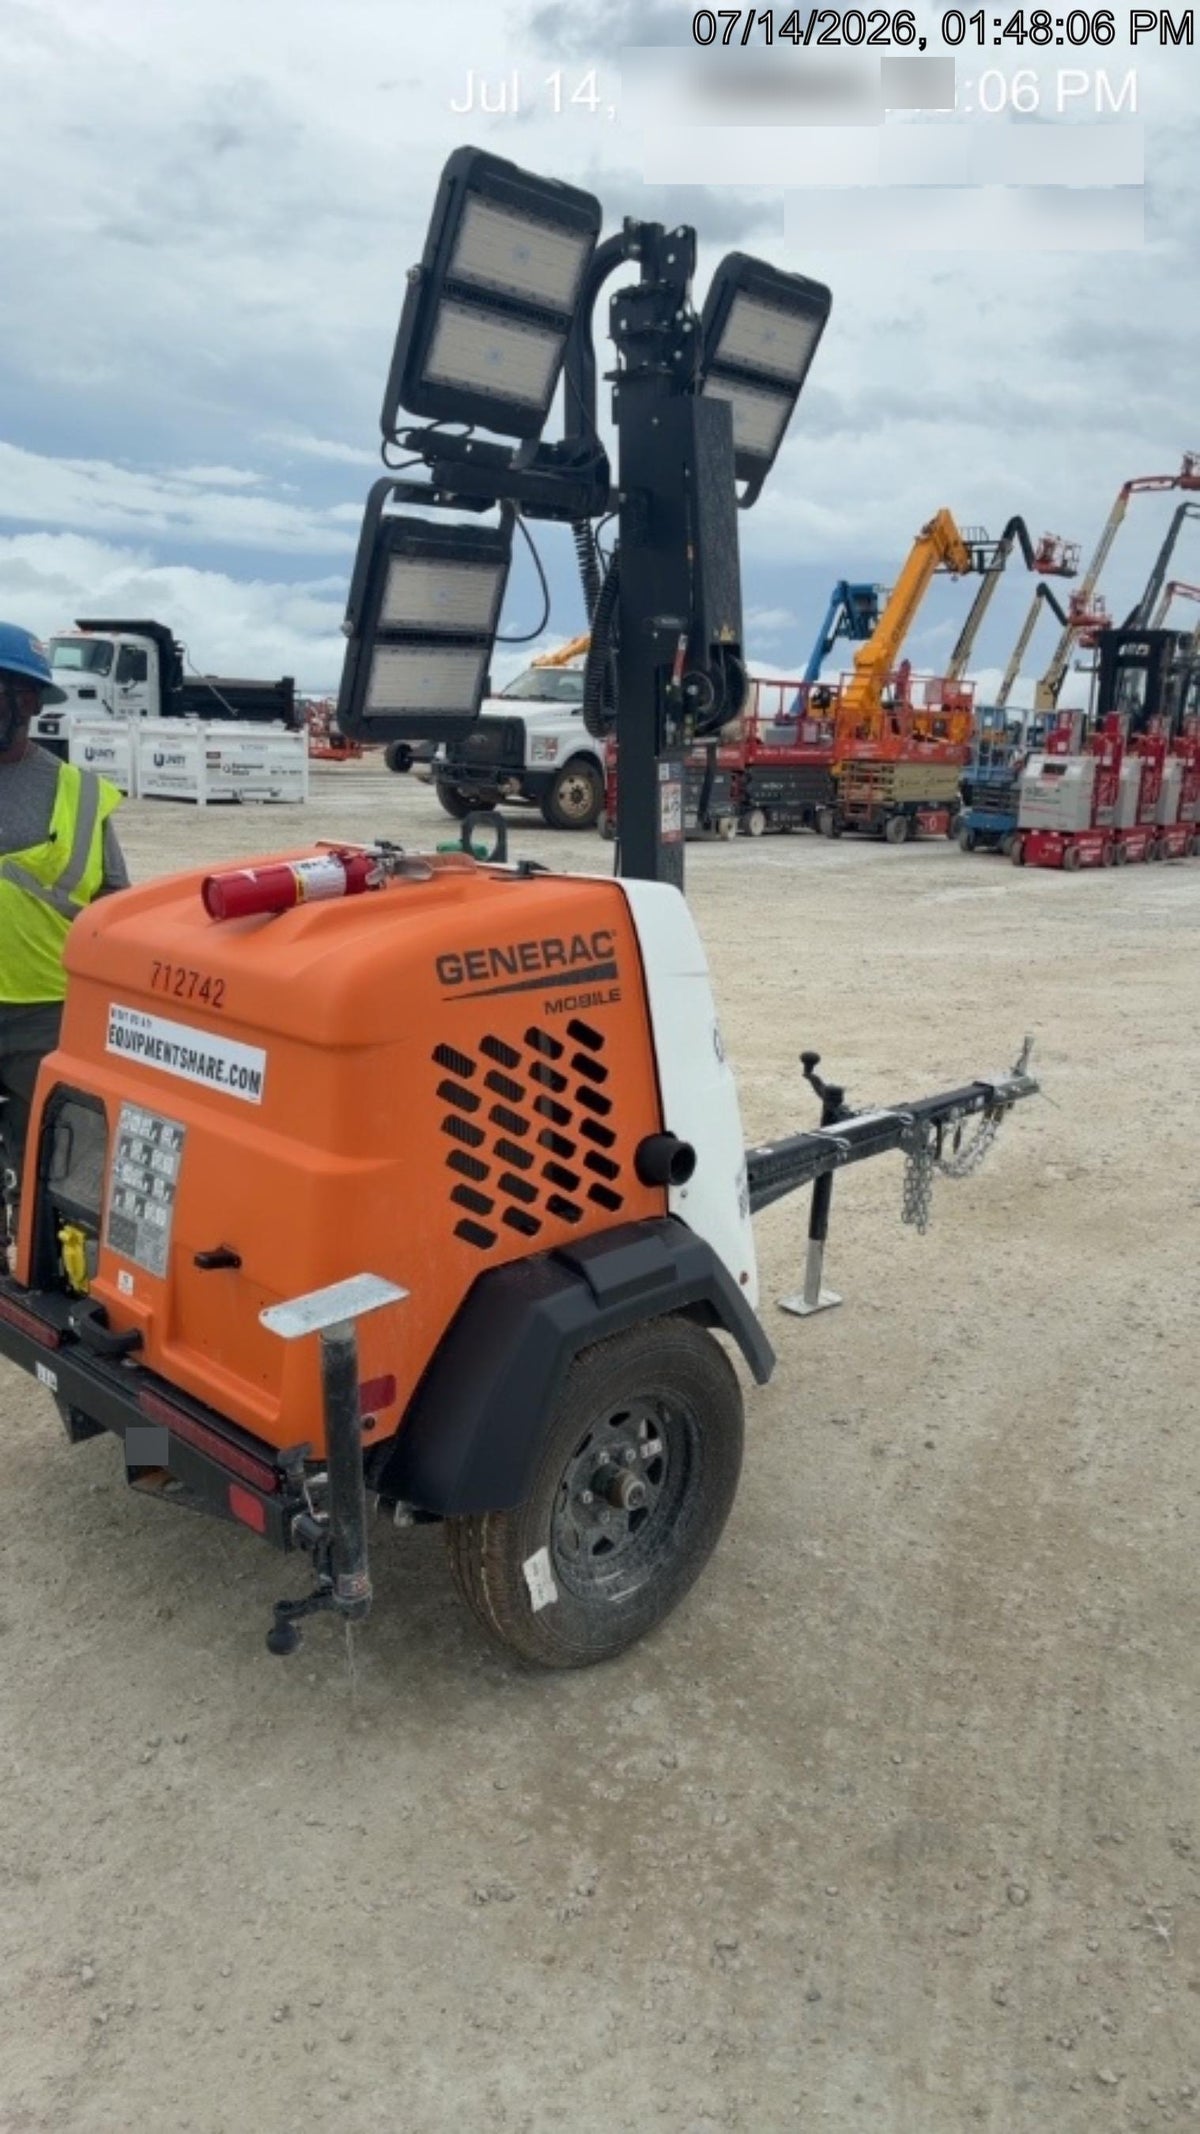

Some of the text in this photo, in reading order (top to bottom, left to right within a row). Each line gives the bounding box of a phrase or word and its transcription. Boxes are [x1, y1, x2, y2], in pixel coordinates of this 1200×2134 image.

[435, 929, 615, 986] GENERAC
[150, 960, 227, 1008] 712742
[544, 987, 622, 1016] MOBILE
[108, 1024, 262, 1096] EQUIPMENTSHARE.COM
